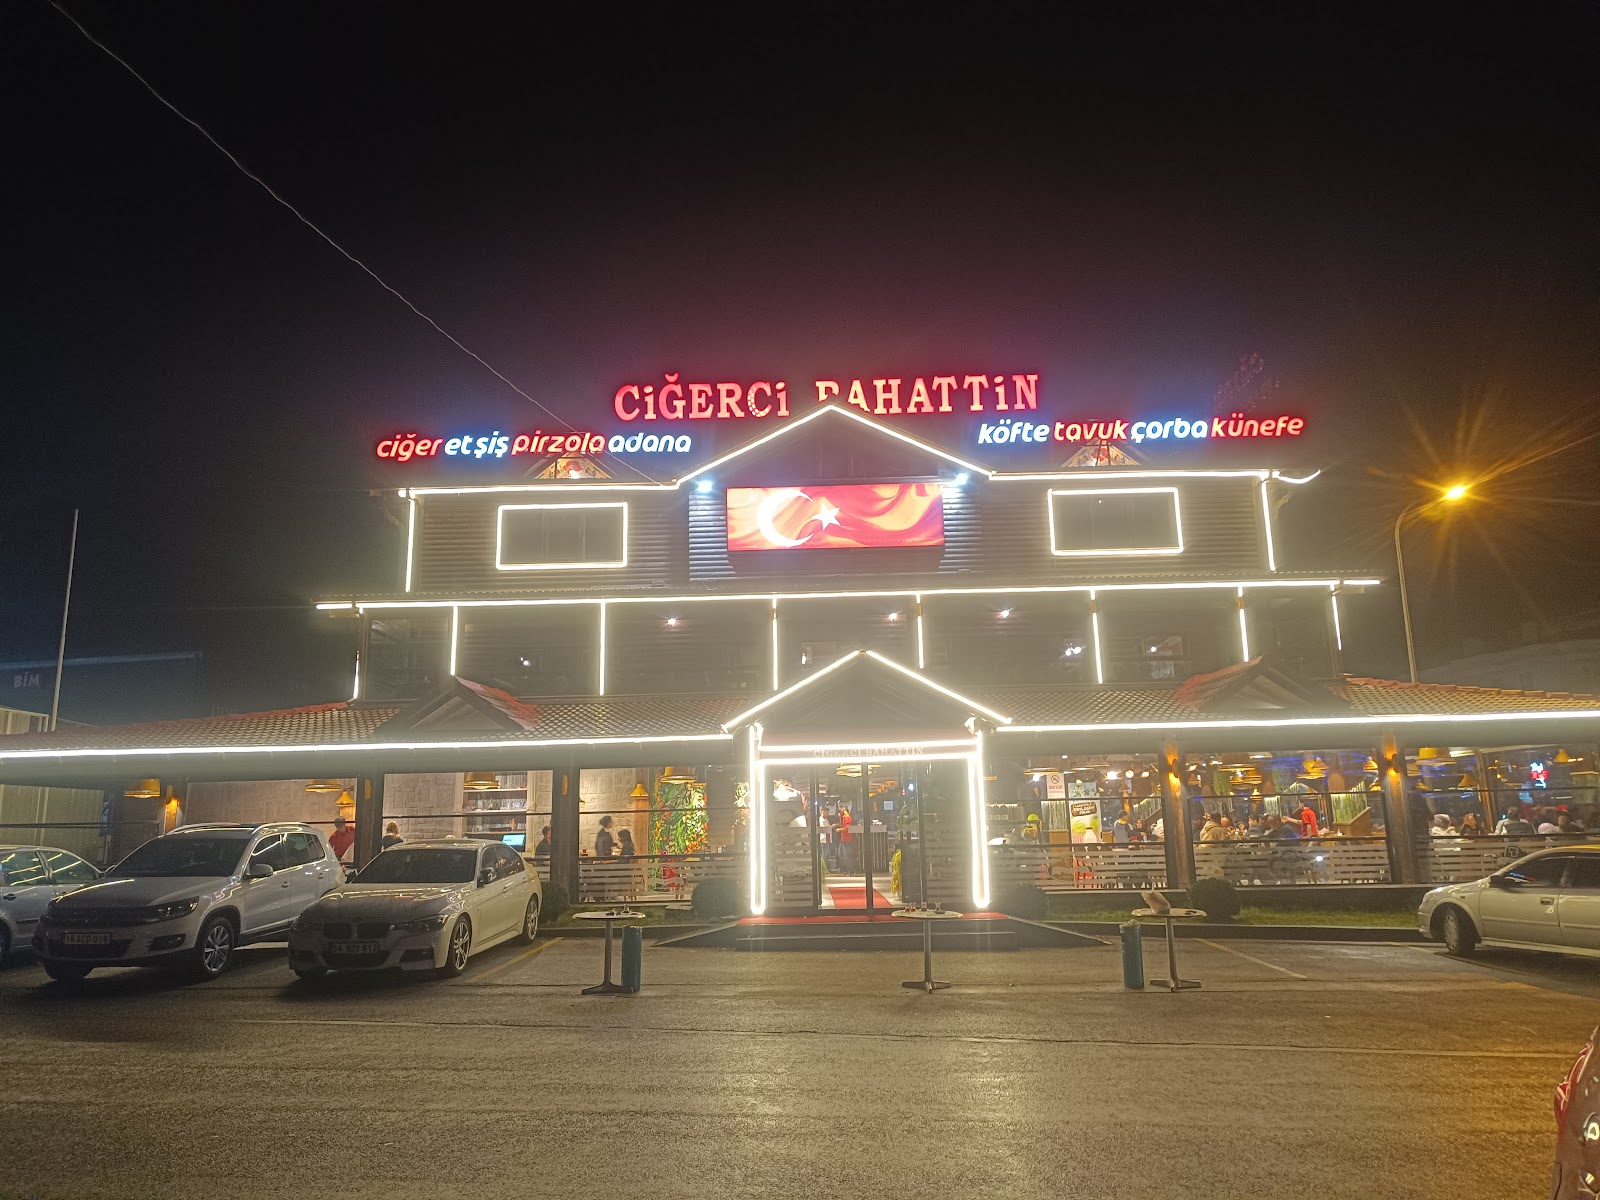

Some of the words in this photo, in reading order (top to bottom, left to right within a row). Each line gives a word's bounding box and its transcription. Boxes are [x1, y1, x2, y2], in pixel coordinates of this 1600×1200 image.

[978, 418, 1050, 444] köfte
[1053, 420, 1130, 442] tavuk
[1130, 418, 1208, 444] çorba
[1210, 412, 1305, 438] künefe
[376, 433, 443, 462] ciğer
[444, 434, 473, 456] et
[475, 430, 509, 459] şiş
[511, 429, 605, 457] pirzola
[608, 432, 692, 454] adana
